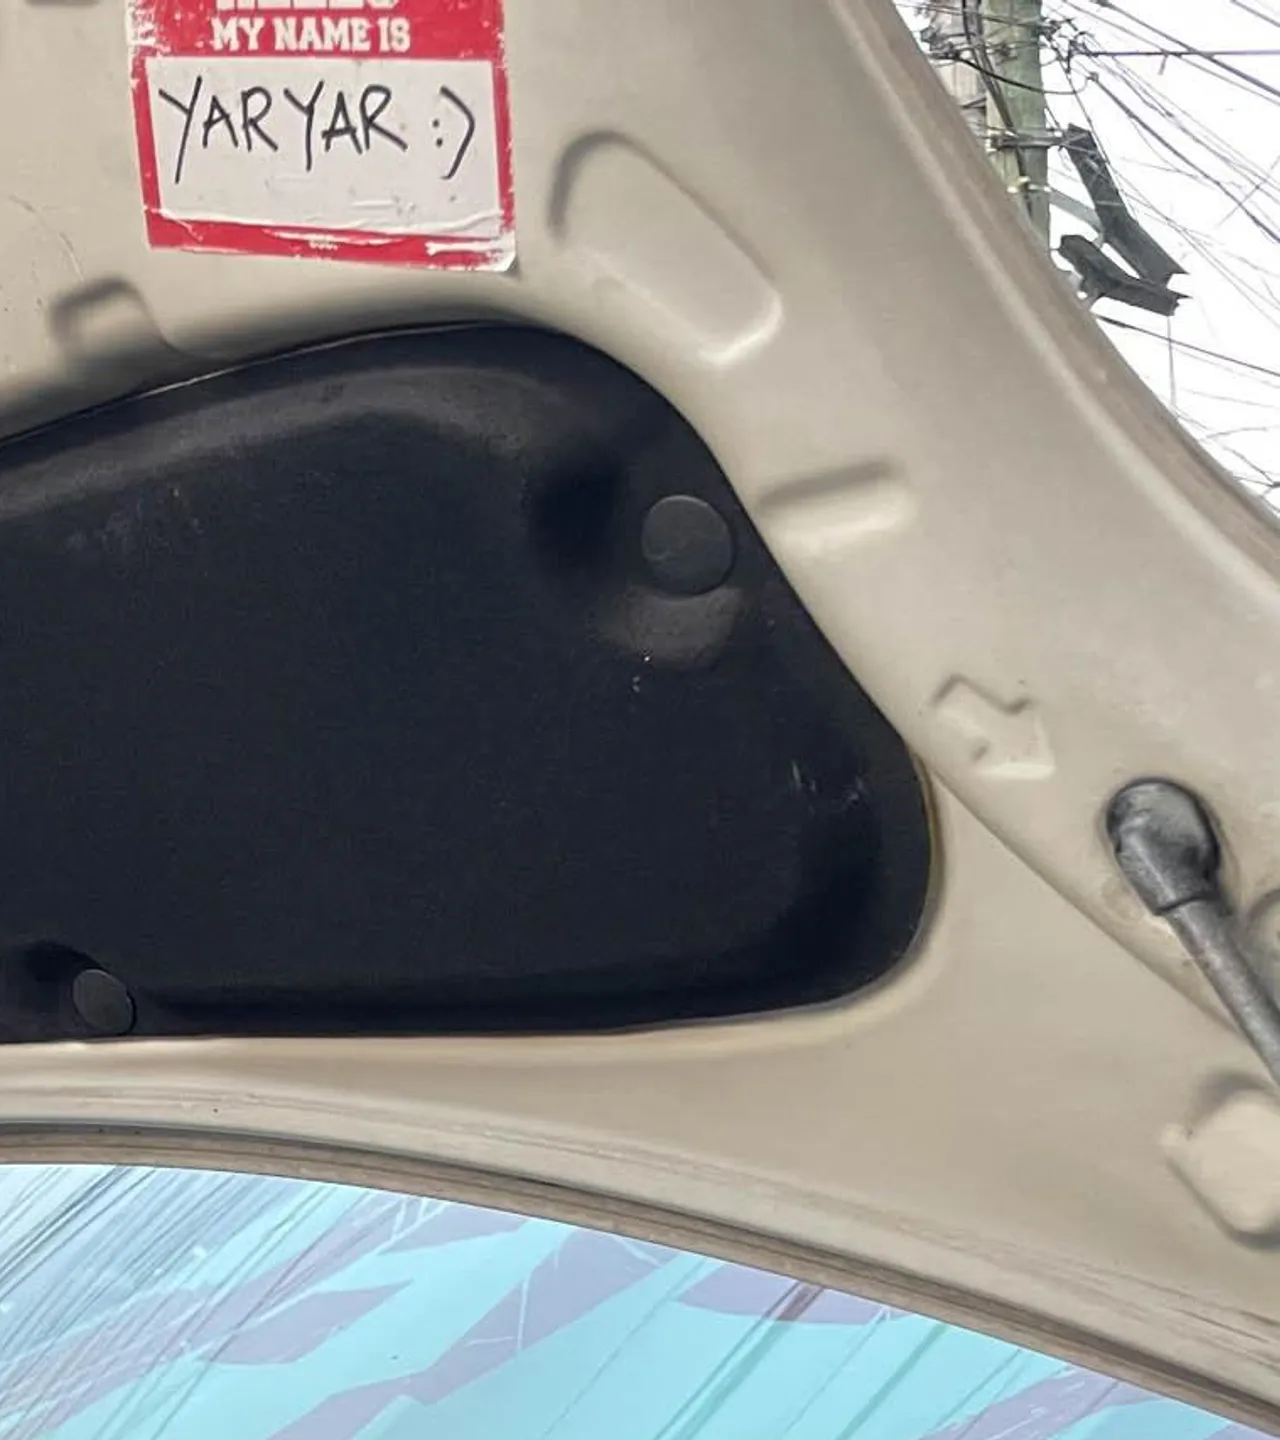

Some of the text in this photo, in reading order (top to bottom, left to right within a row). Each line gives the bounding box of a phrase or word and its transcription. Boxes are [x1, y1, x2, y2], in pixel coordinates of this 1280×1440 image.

[211, 16, 411, 52] MY NAME IS
